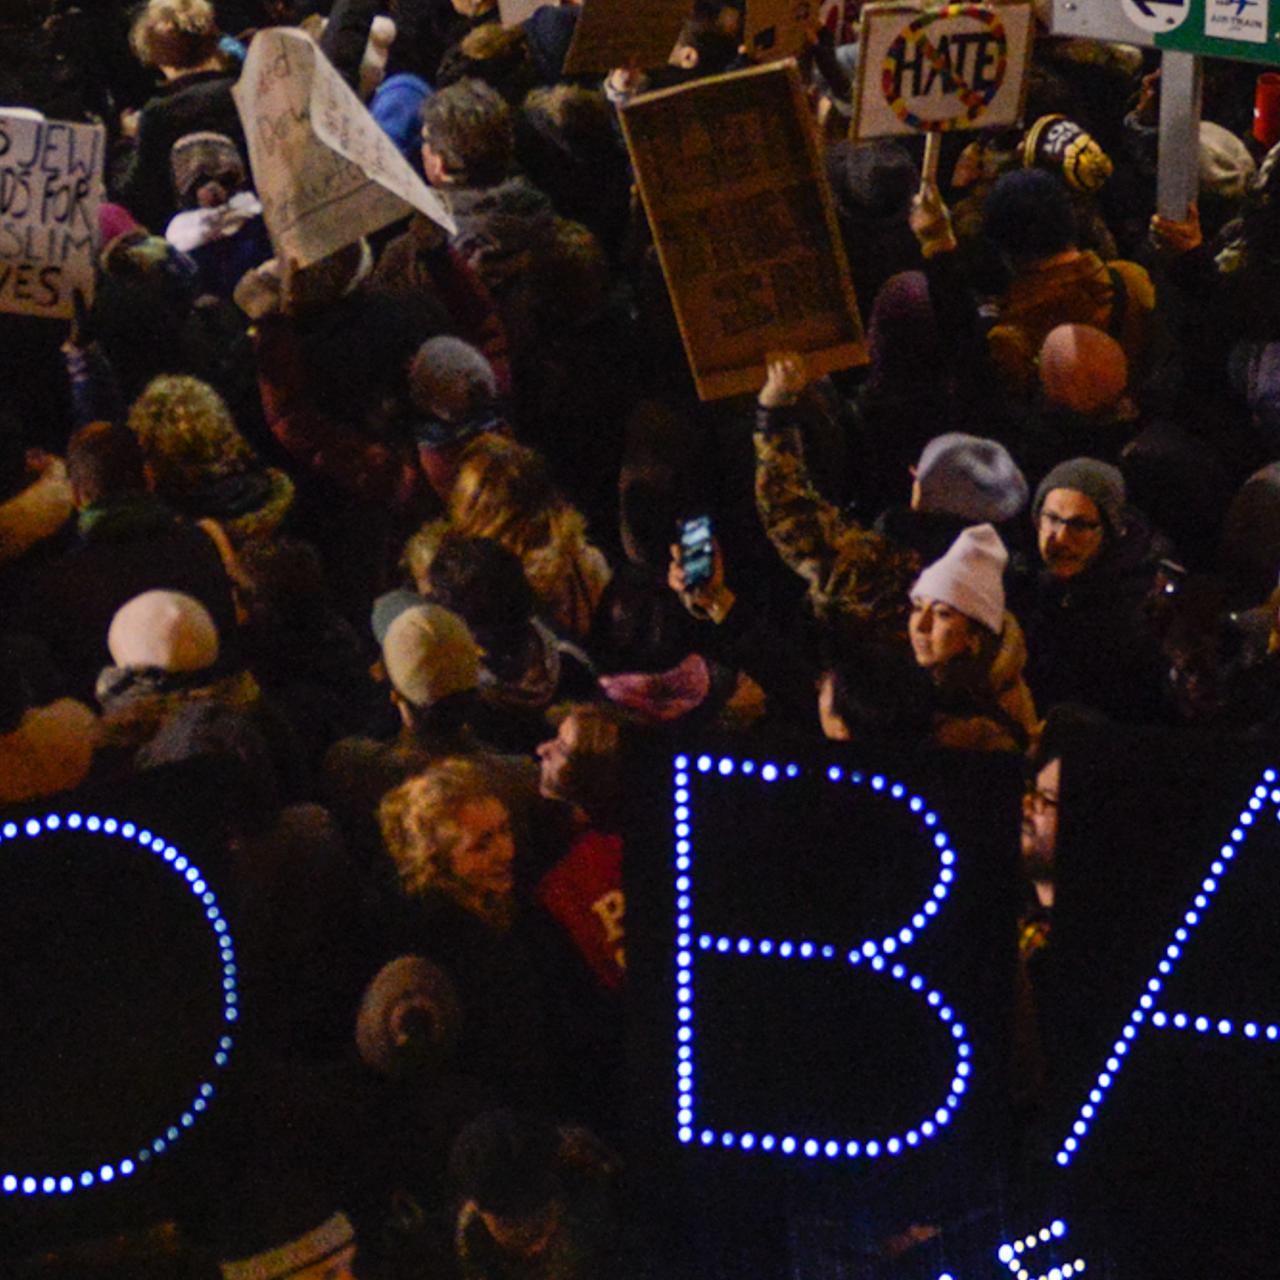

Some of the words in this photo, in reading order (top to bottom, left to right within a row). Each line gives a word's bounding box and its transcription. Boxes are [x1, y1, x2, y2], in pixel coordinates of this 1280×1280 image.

[892, 32, 997, 97] HATE
[17, 121, 100, 178] JEW
[41, 170, 95, 225] FOR
